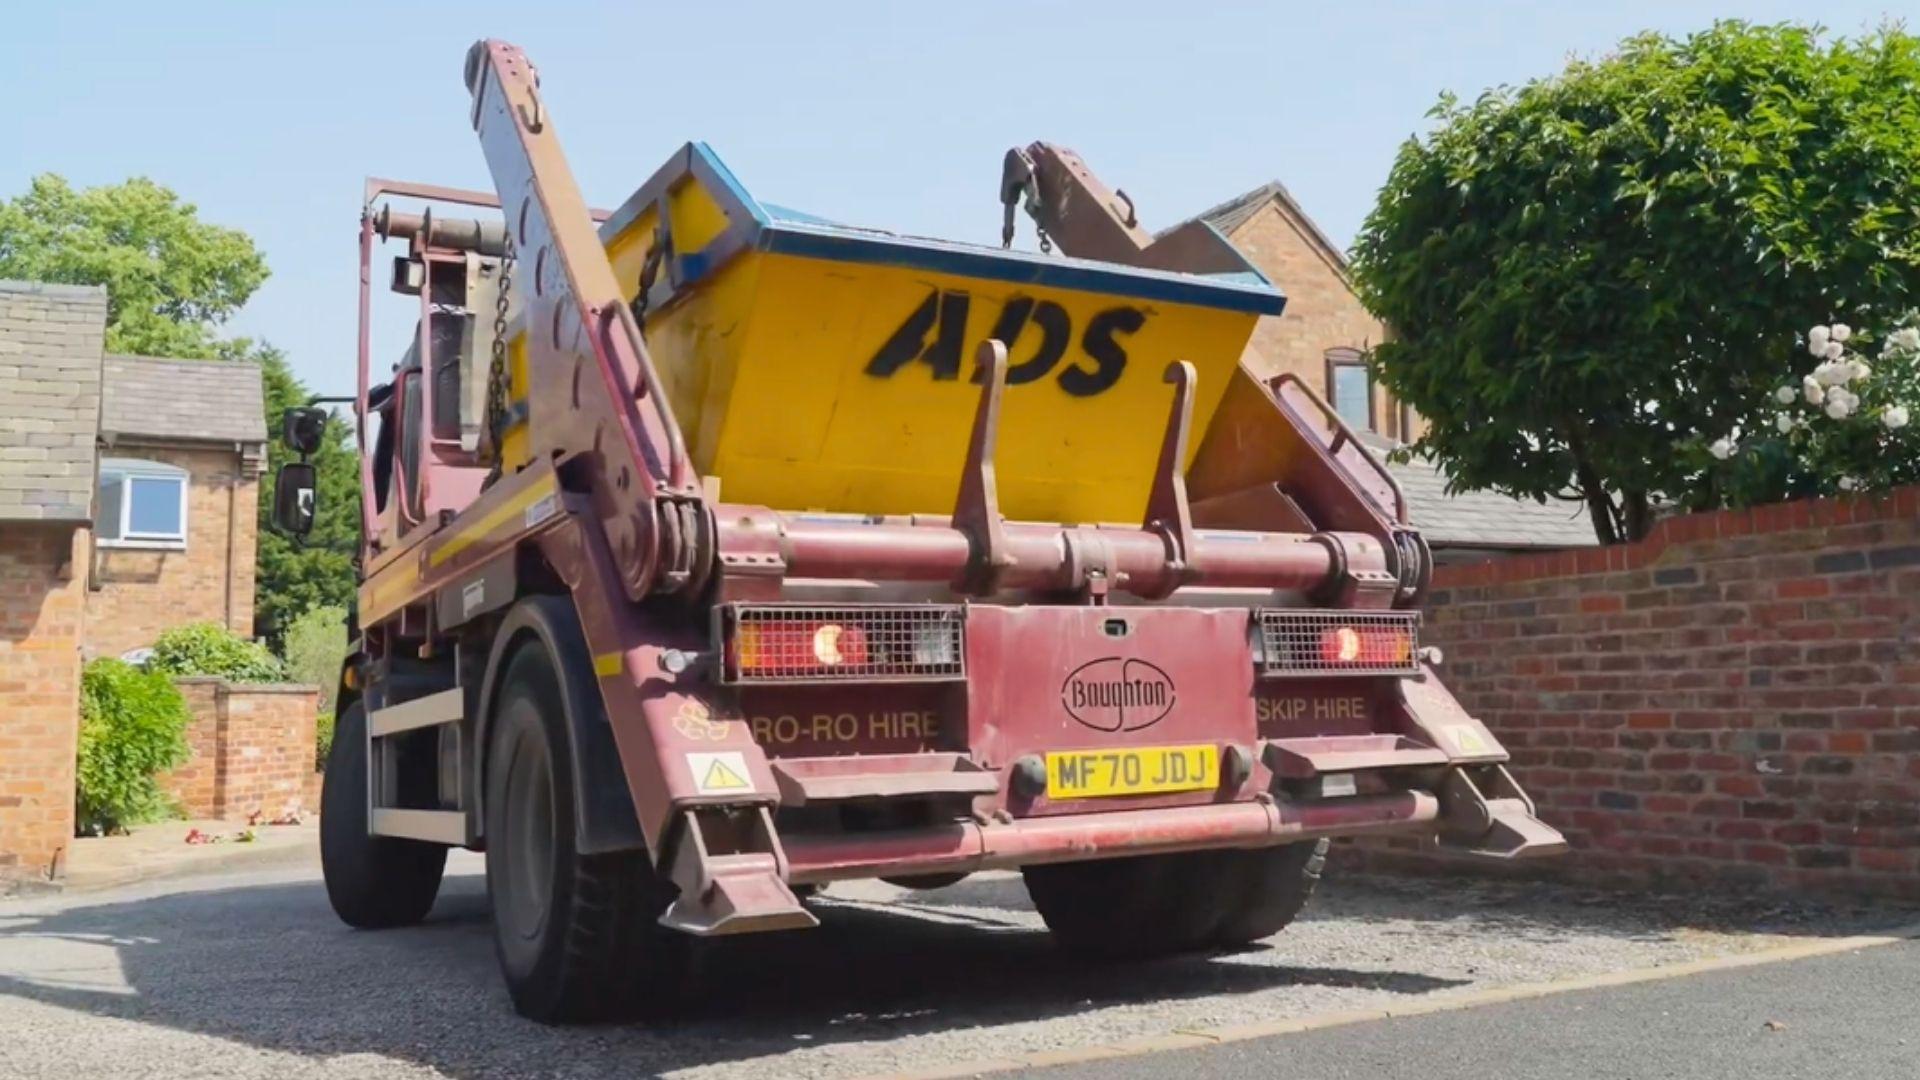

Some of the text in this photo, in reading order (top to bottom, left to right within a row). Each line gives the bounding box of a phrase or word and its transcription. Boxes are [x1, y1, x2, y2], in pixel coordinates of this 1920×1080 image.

[863, 287, 1149, 397] ADS
[1071, 678, 1167, 708] Boughton
[1258, 697, 1366, 721] SKIP HIRE
[752, 711, 940, 744] RO-RO HIRE
[1057, 751, 1206, 789] MF70 JDJ
